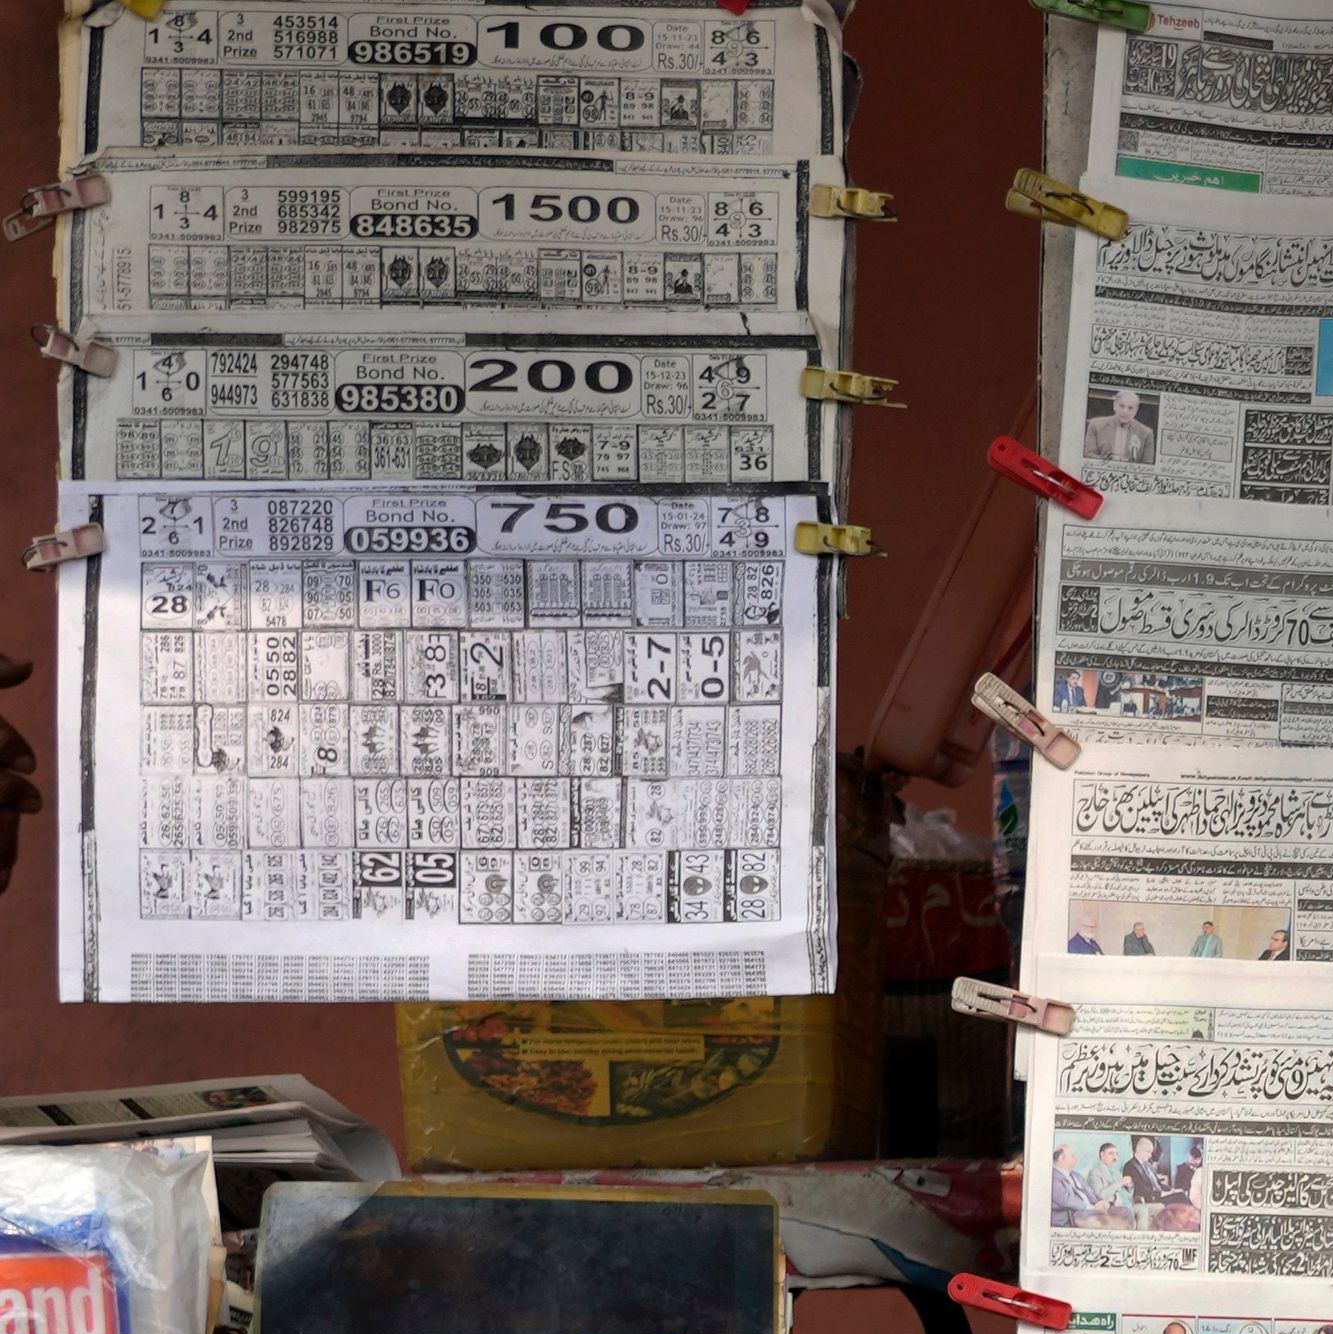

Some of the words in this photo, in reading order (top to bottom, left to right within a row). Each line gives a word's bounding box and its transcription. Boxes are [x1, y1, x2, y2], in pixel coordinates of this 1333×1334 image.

[273, 16, 338, 29] 453514
[274, 31, 338, 44] 516988
[370, 26, 417, 38] Bond
[426, 26, 457, 39] No.
[487, 22, 645, 50] 100
[273, 46, 337, 59] 571071
[355, 41, 471, 64] 986519
[278, 190, 341, 203] 599195
[278, 205, 341, 218] 685342
[492, 194, 640, 223] 1500
[278, 221, 341, 234] 982975
[356, 216, 472, 237] 848635
[211, 353, 257, 373] 792424
[271, 355, 329, 370] 294748
[356, 366, 405, 380] Bond
[414, 367, 445, 380] No.
[469, 359, 633, 393] 200
[272, 373, 329, 389] 577563
[211, 384, 257, 405] 944973
[272, 392, 329, 408] 631838
[341, 386, 458, 411] 985380
[268, 500, 332, 515] 087220
[268, 518, 333, 533] 826748
[491, 503, 638, 533] 750
[269, 536, 333, 550] 892829
[351, 528, 472, 551] 059936
